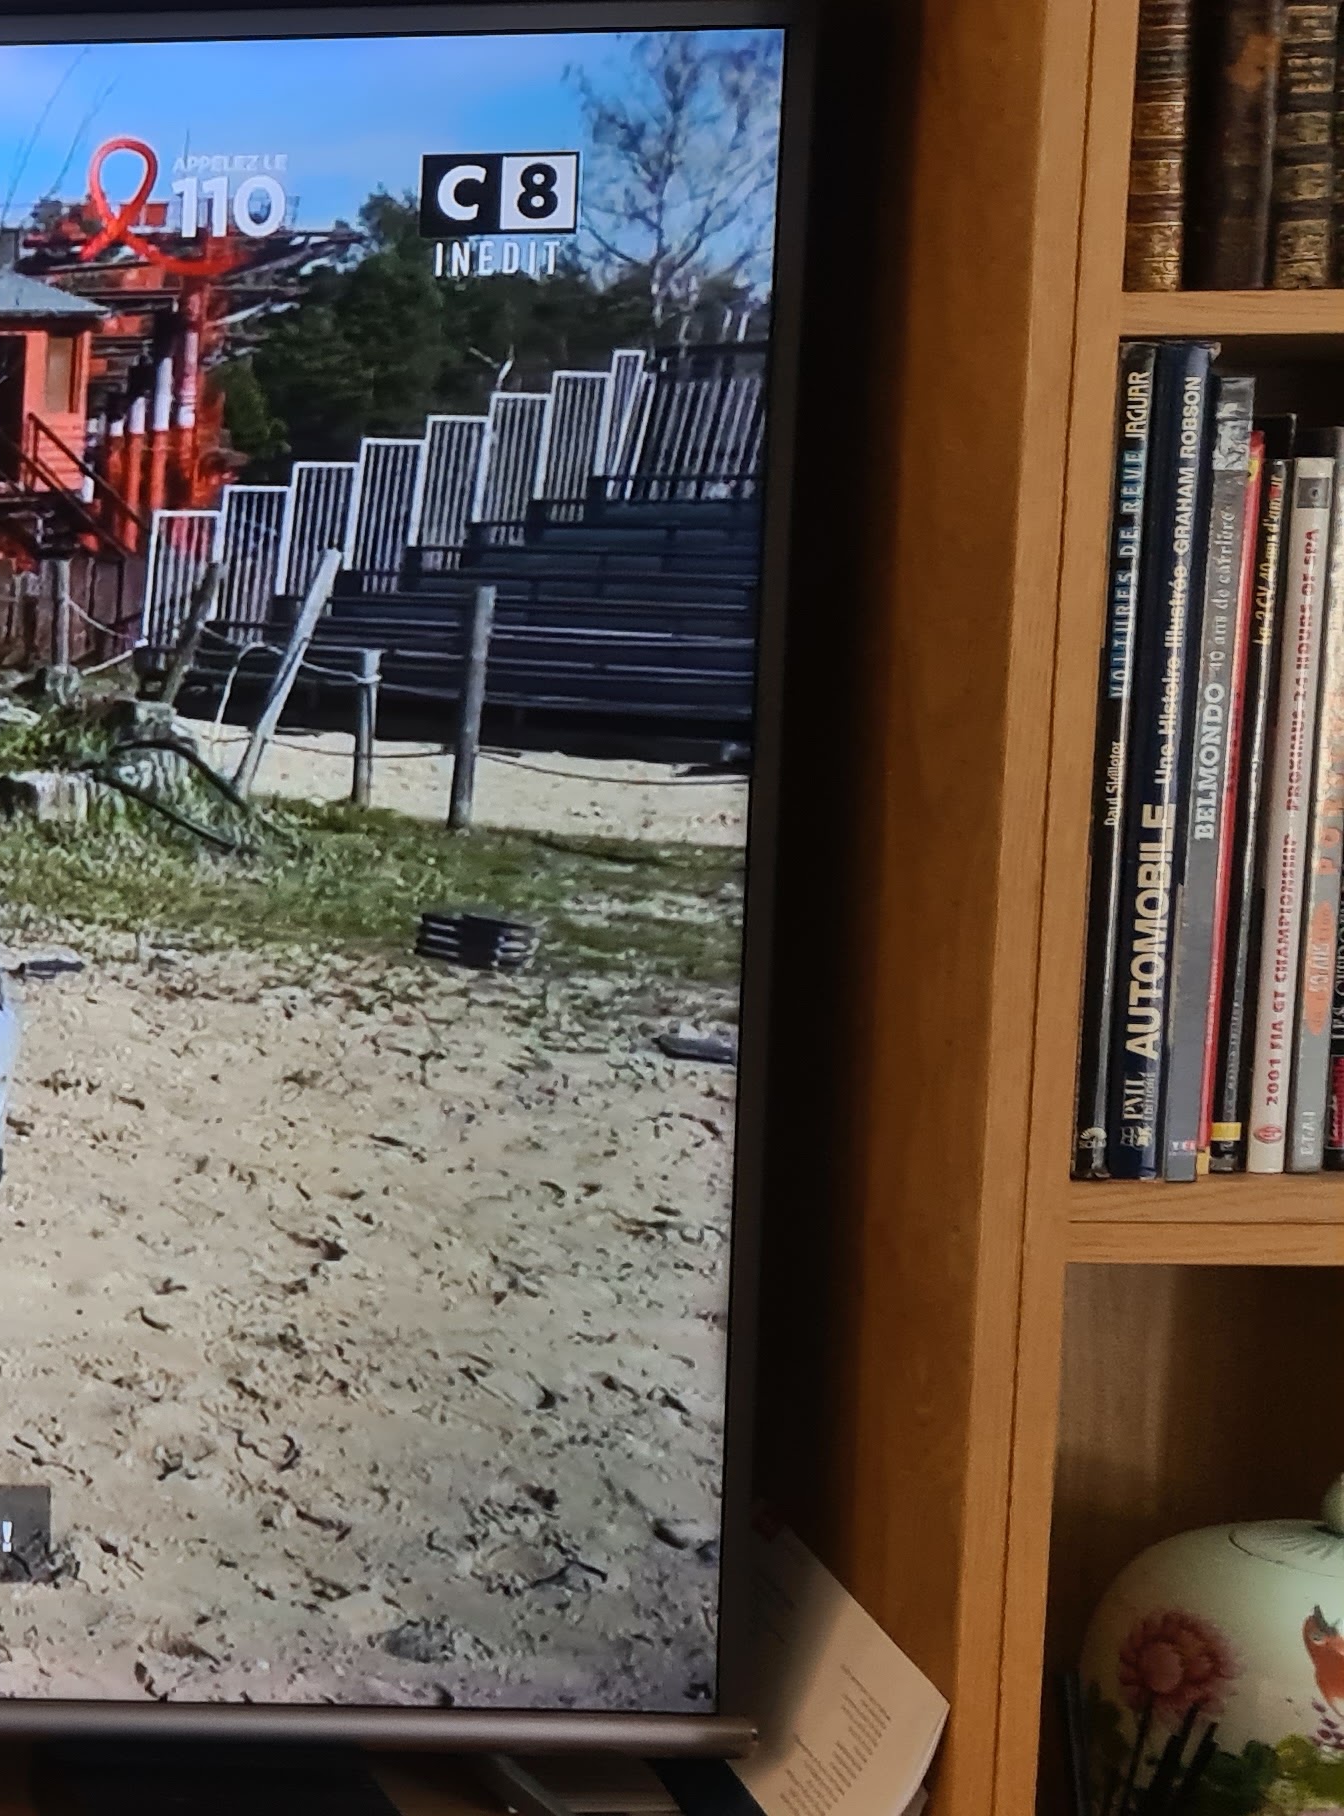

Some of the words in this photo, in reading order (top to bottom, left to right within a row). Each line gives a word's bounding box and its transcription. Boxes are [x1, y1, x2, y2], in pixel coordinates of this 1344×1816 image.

[172, 153, 260, 172] APPELEZ
[263, 153, 288, 171] LE
[171, 174, 286, 239] 110
[434, 239, 561, 278] INEDIT
[1124, 370, 1152, 441] JAGUAR
[1181, 375, 1203, 460] ROBSON
[1172, 466, 1196, 556] GRAHAM
[1117, 525, 1140, 557] DE
[1302, 528, 1320, 566] SPA
[1108, 570, 1136, 698] VOITURES
[1157, 656, 1182, 736] Histoire
[1154, 742, 1174, 784] Une
[1193, 682, 1225, 841] BELMONDO
[1103, 797, 1120, 826] Paul
[1125, 802, 1177, 1060] AUTOMOBILE
[1272, 833, 1297, 983] CHAMPIONSHIP
[1272, 990, 1287, 1013] GT
[1269, 1019, 1285, 1050] FIA
[1122, 1071, 1145, 1121] PML
[1265, 1058, 1281, 1106] 2001
